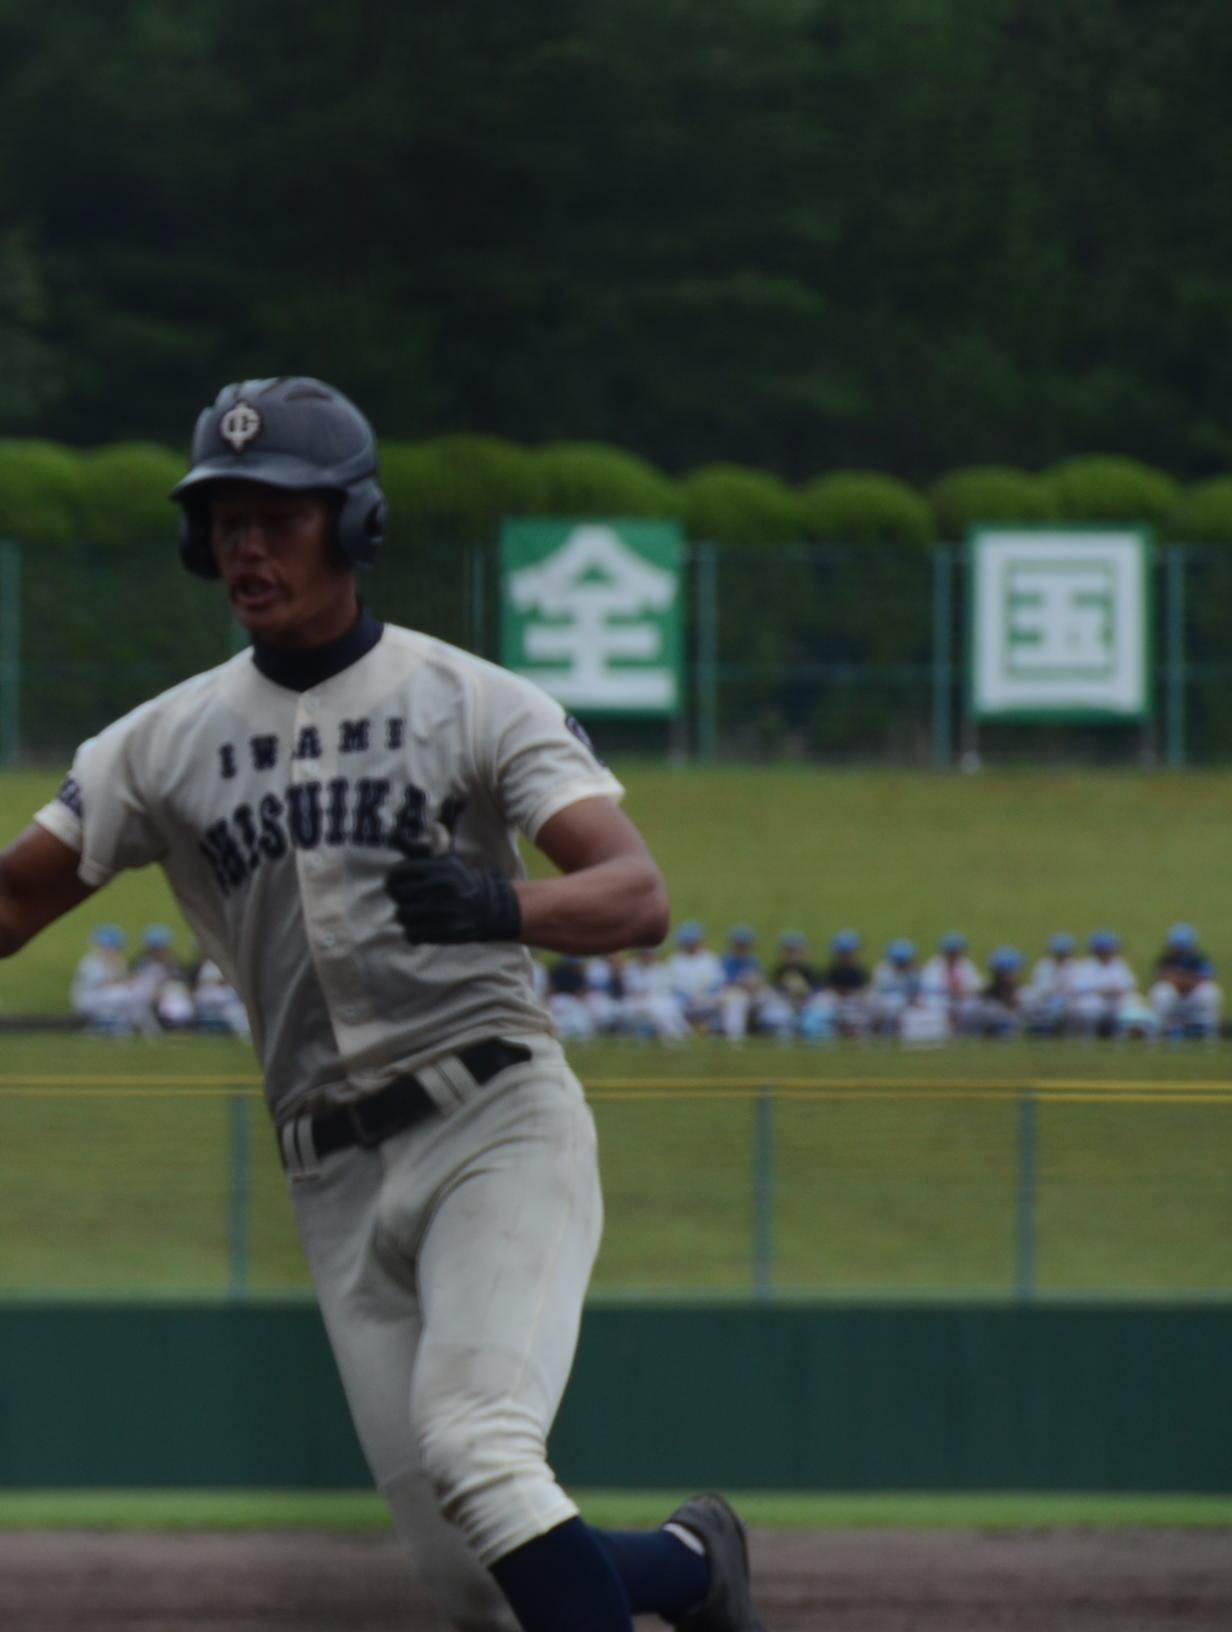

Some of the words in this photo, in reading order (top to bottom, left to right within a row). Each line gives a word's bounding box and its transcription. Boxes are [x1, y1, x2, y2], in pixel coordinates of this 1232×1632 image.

[510, 524, 676, 710] 全
[974, 529, 1142, 714] 国
[220, 717, 404, 779] IWAMI
